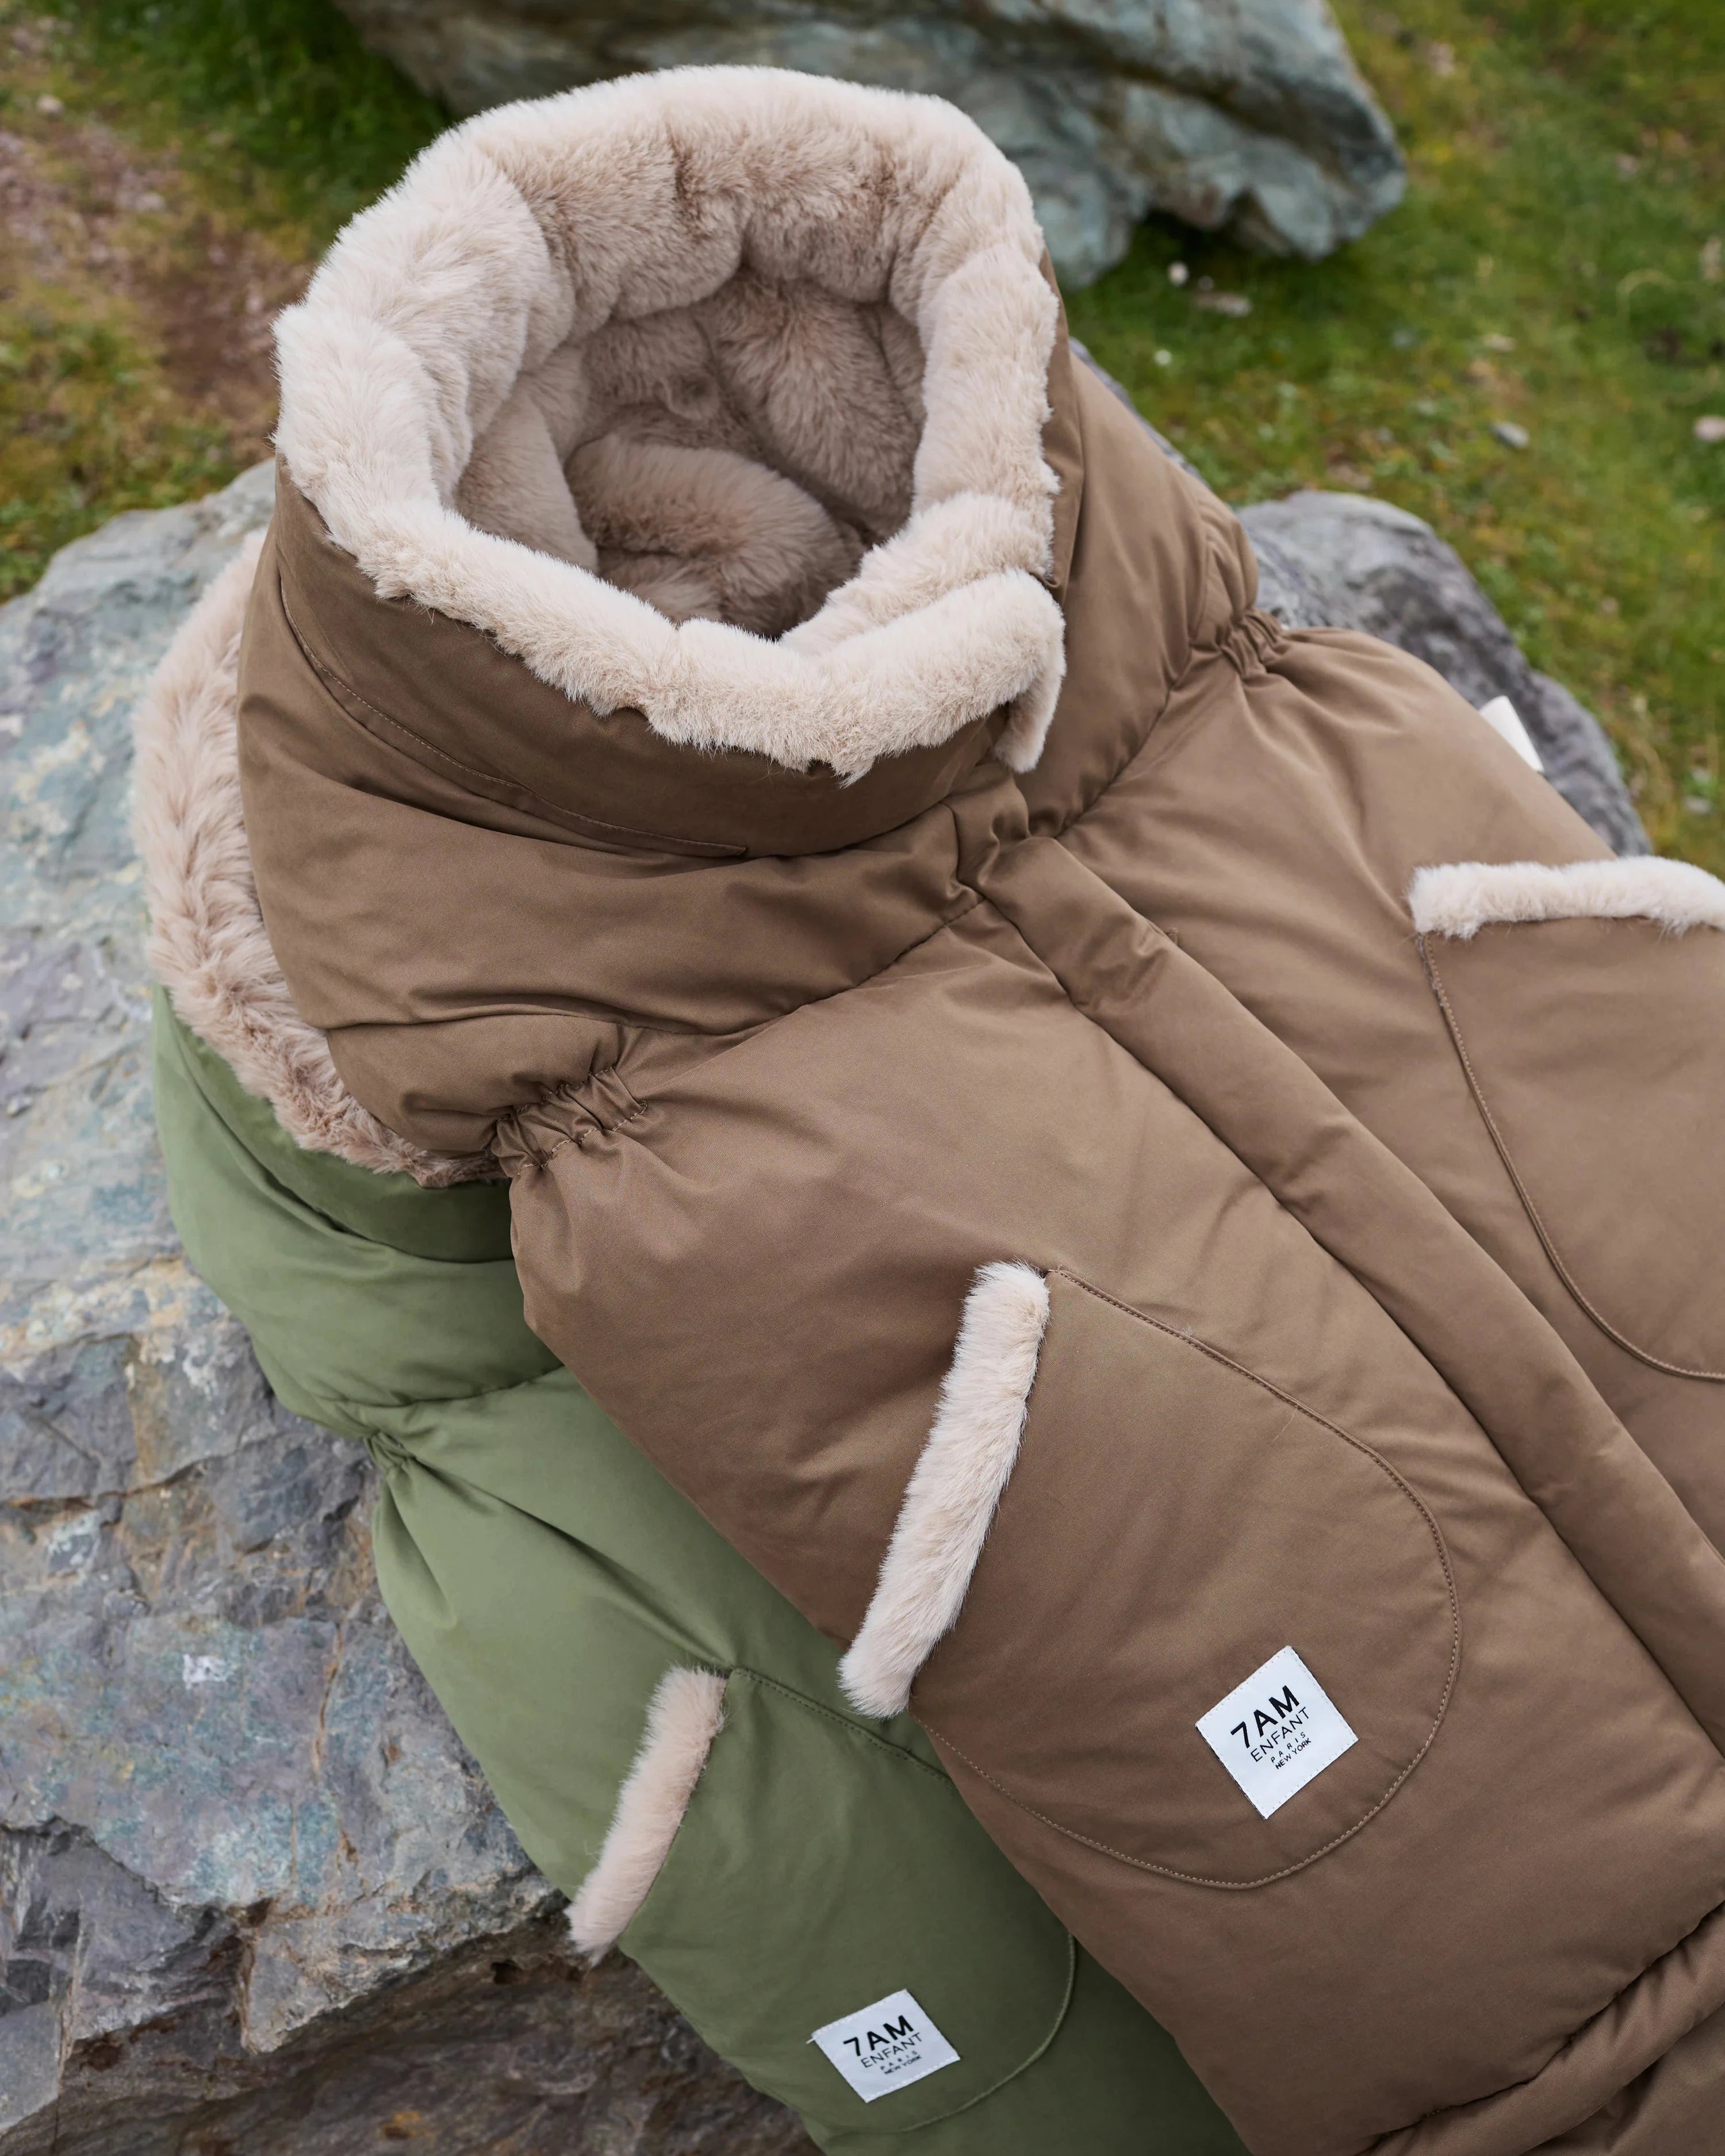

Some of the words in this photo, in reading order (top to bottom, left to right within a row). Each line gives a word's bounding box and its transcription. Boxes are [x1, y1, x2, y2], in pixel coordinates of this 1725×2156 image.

[1230, 1685, 1300, 1748] 7AM
[1251, 1706, 1309, 1762] ENFANT
[1271, 1732, 1306, 1763] PARIS
[1275, 1755, 1292, 1770] NEW
[1291, 1738, 1312, 1755] YORK
[843, 2015, 914, 2057] 7AM
[861, 2032, 922, 2068] ENFANT
[880, 2050, 918, 2070] PARIS
[884, 2065, 901, 2075] NEW
[902, 2055, 922, 2067] YORK
